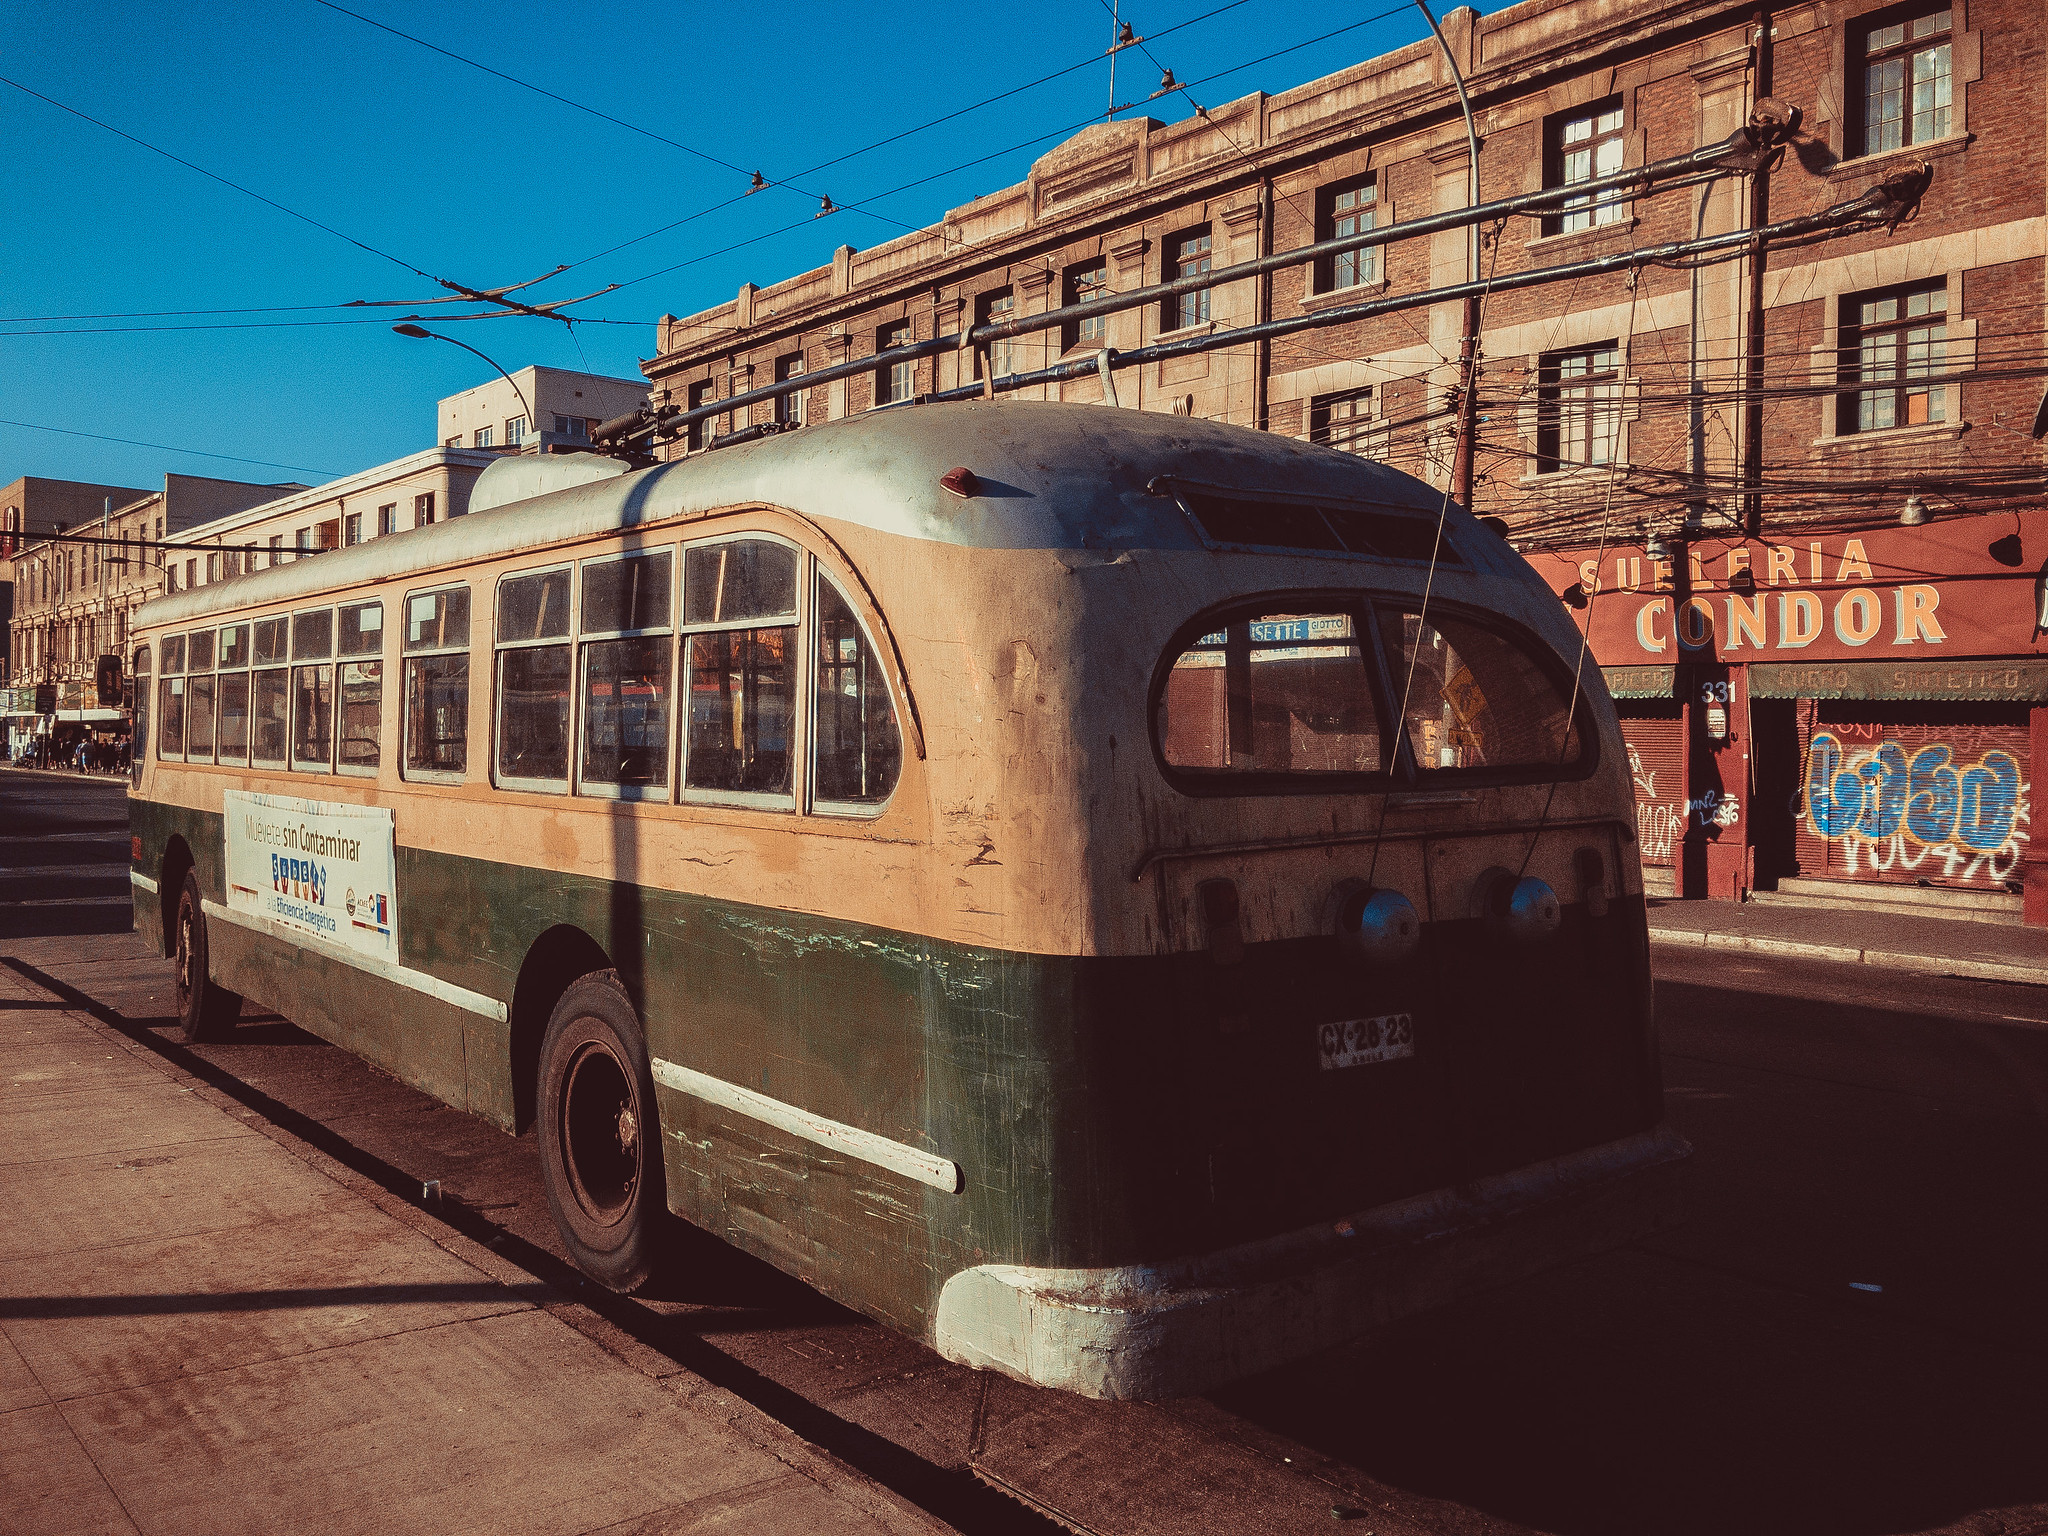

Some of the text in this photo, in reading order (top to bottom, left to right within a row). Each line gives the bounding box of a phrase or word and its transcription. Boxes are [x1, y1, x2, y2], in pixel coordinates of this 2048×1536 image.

[1579, 539, 1874, 596] SUELERIA
[1636, 584, 1947, 653] CONDOR
[1702, 681, 1736, 703] 331
[1779, 669, 2020, 690] CUERO SINTETICO
[245, 814, 361, 862] Muévete sin Contaminar
[277, 897, 304, 920] Eficiencia
[304, 905, 336, 932] Energética
